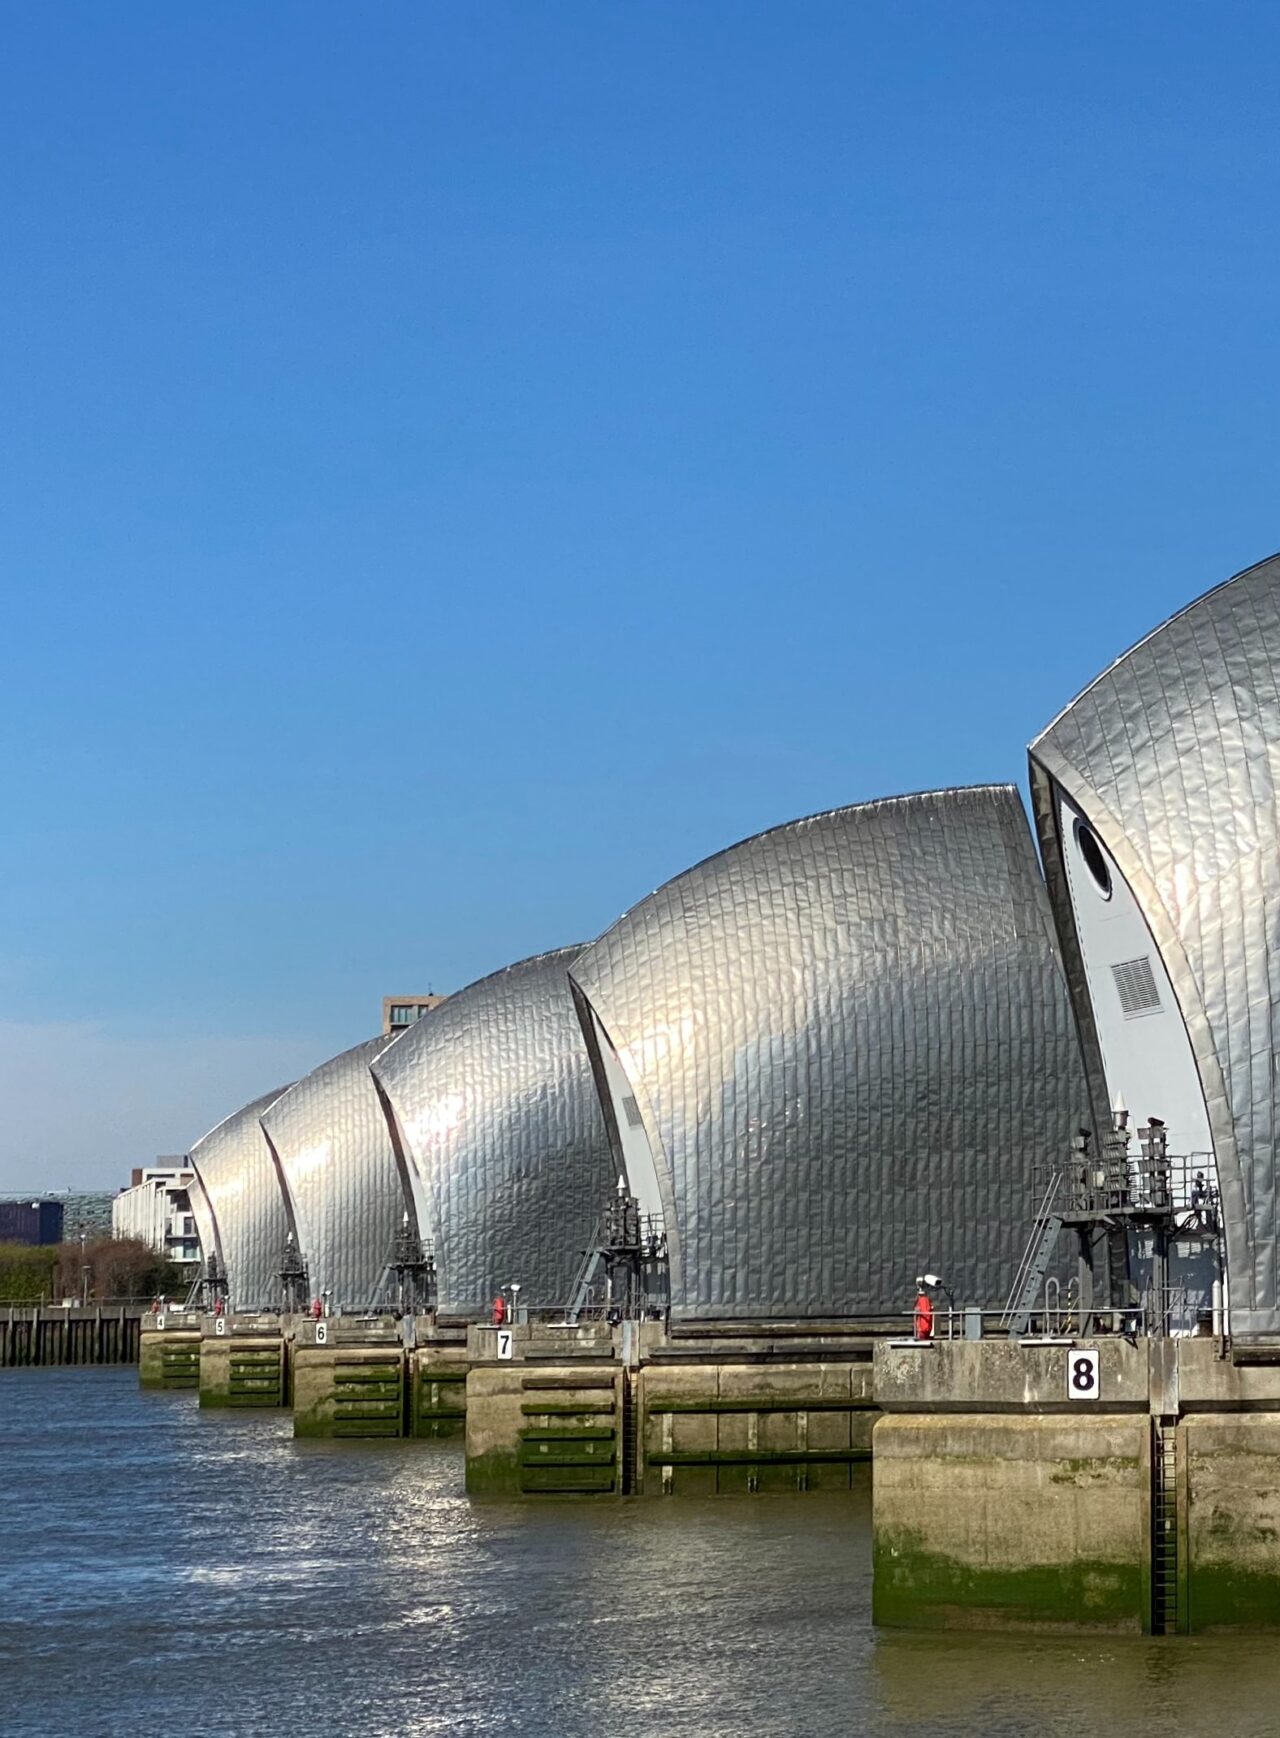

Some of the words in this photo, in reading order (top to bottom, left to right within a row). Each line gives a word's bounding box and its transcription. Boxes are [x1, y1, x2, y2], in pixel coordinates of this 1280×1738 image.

[217, 1321, 223, 1332] 5
[317, 1326, 324, 1340] 6
[500, 1334, 510, 1355] 7
[1072, 1357, 1095, 1391] 8
